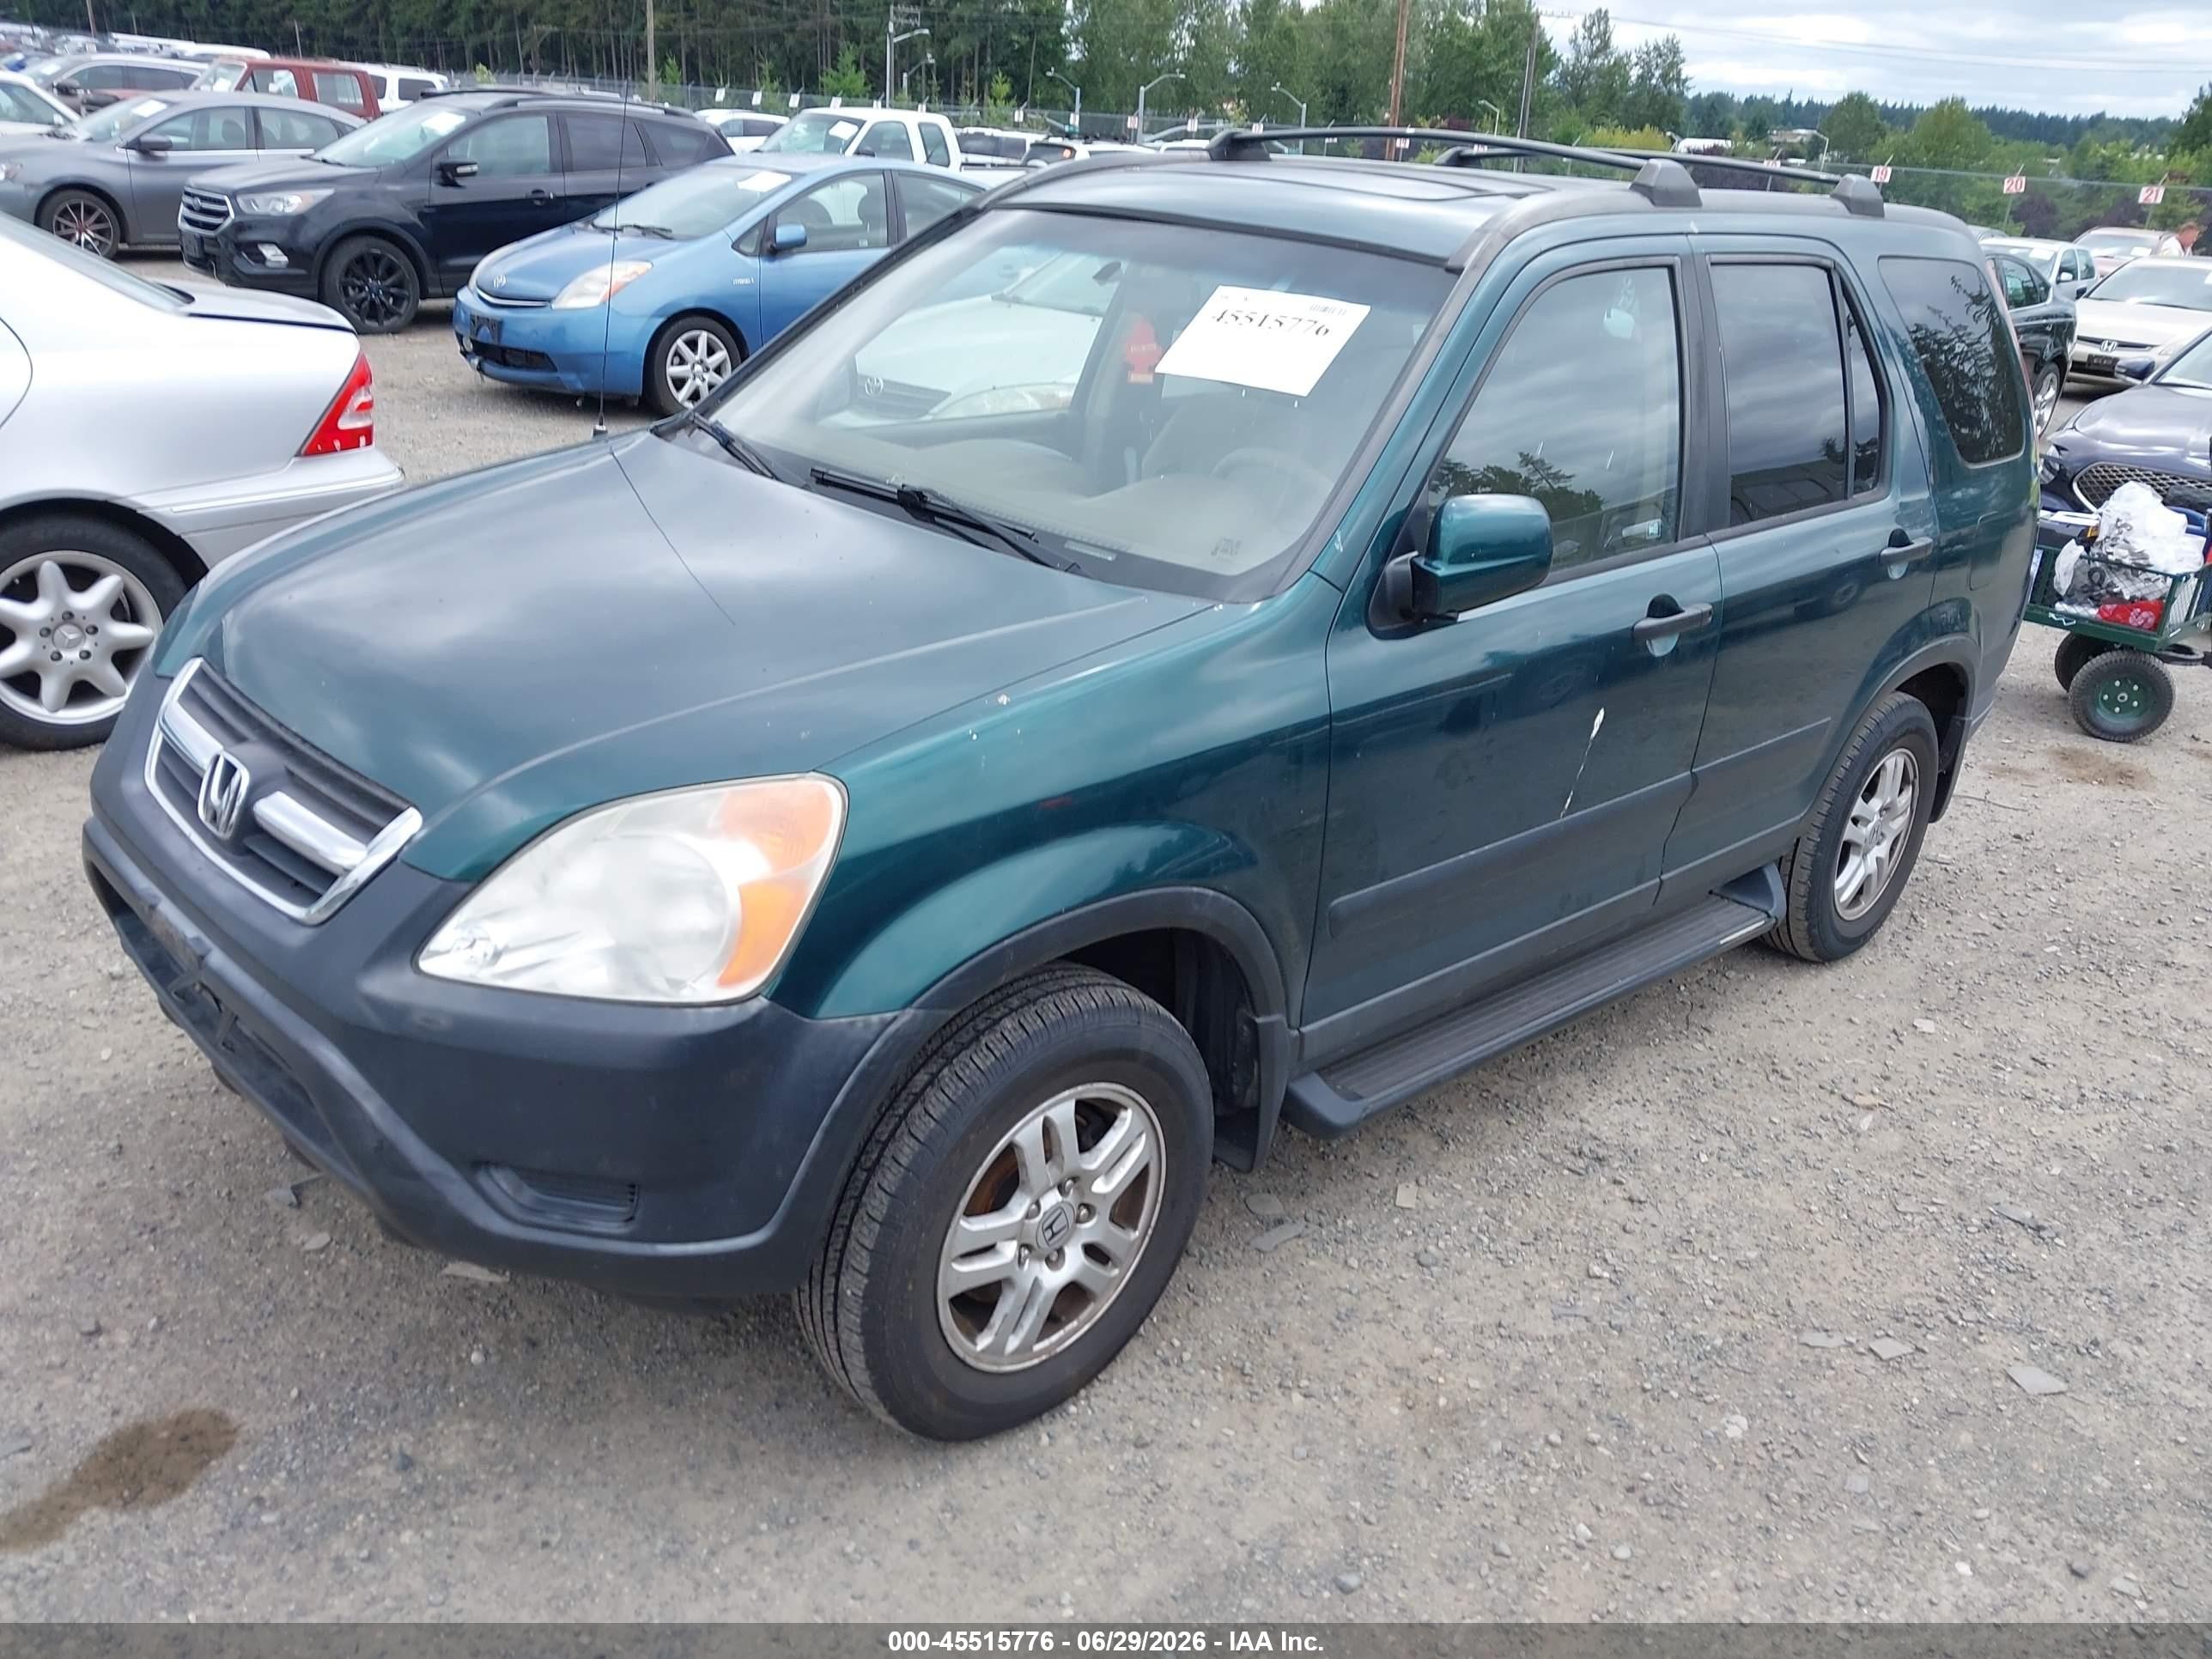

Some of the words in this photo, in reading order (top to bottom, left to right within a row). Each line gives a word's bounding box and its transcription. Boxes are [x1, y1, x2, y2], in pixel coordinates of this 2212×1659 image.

[1875, 167, 1888, 181] 19
[2005, 178, 2023, 192] 20
[2142, 186, 2160, 203] 21
[1212, 308, 1330, 337] 45515776
